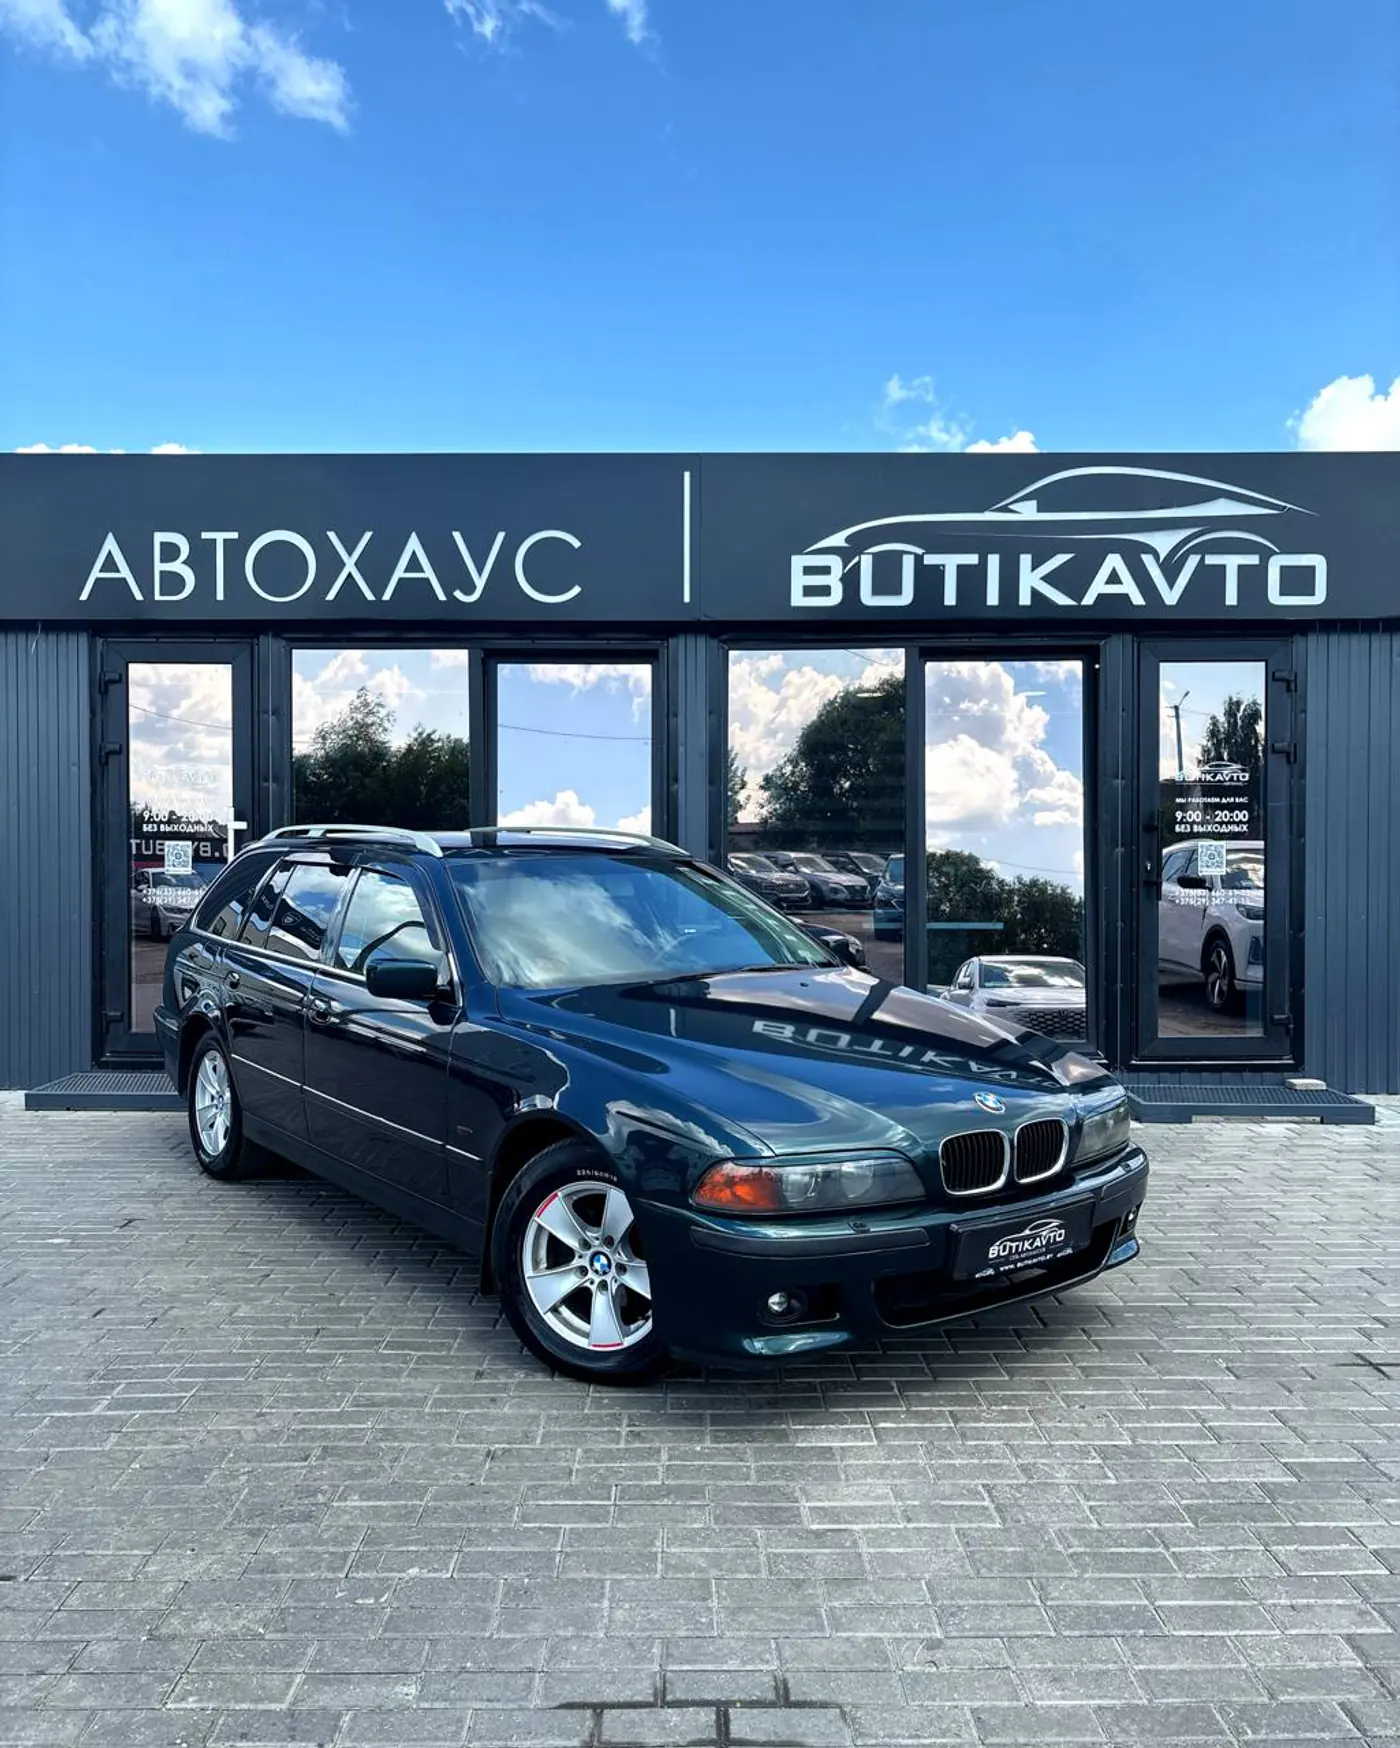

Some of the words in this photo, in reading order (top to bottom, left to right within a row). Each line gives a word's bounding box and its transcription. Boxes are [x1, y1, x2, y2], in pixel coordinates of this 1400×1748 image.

[79, 529, 582, 604] АВТОХАУС
[790, 553, 1327, 607] BUTIKAVTO
[1175, 811, 1202, 822] 9:00
[1214, 811, 1249, 822] 20:00
[142, 824, 158, 832] БЕЗ
[160, 824, 214, 833] ВЫХОДНЫХ
[1175, 824, 1191, 832] БЕЗ
[1193, 824, 1249, 833] ВЫХОДНЫХ
[988, 1229, 1065, 1259] BUTIKAVTO
